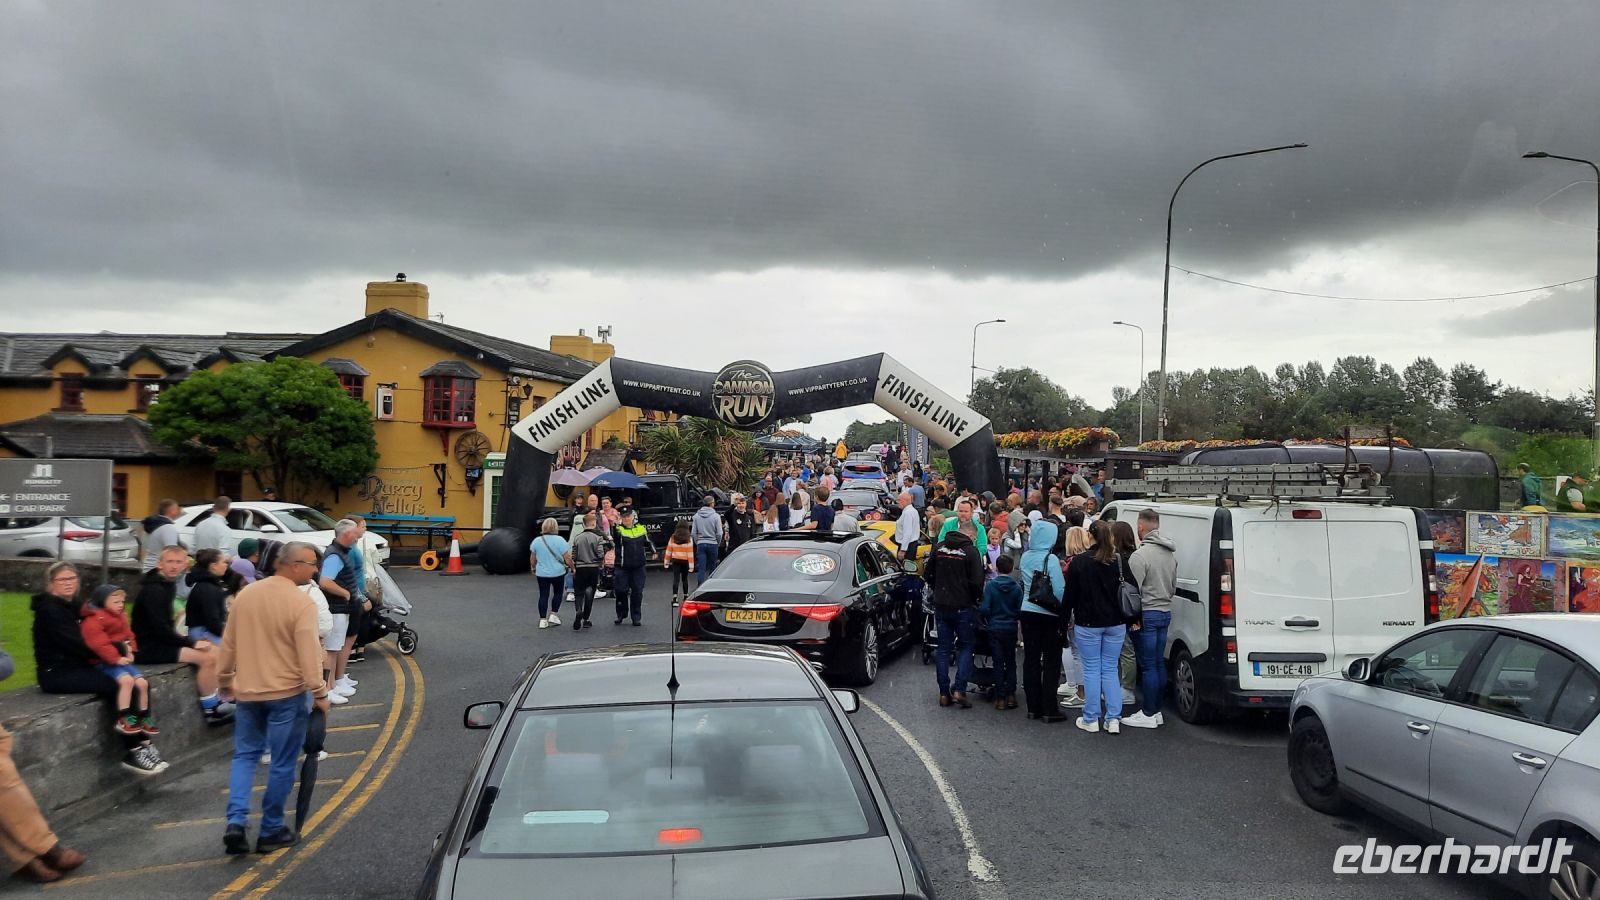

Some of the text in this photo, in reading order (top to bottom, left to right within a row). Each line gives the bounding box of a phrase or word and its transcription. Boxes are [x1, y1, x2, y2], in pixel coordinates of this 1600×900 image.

[729, 370, 761, 381] The
[713, 381, 775, 394] CANNON
[788, 377, 868, 396] WWW.VIPPARTYTENT.CO.UK
[528, 400, 579, 442] FINISH
[574, 378, 610, 410] LINE
[716, 395, 769, 425] RUN
[881, 373, 968, 437] FINISH LINE
[15, 493, 71, 501] ENTRANCE
[15, 504, 66, 512] CAR PARK
[730, 610, 773, 620] CK23 NGX
[1267, 664, 1312, 675] 191-CE-418
